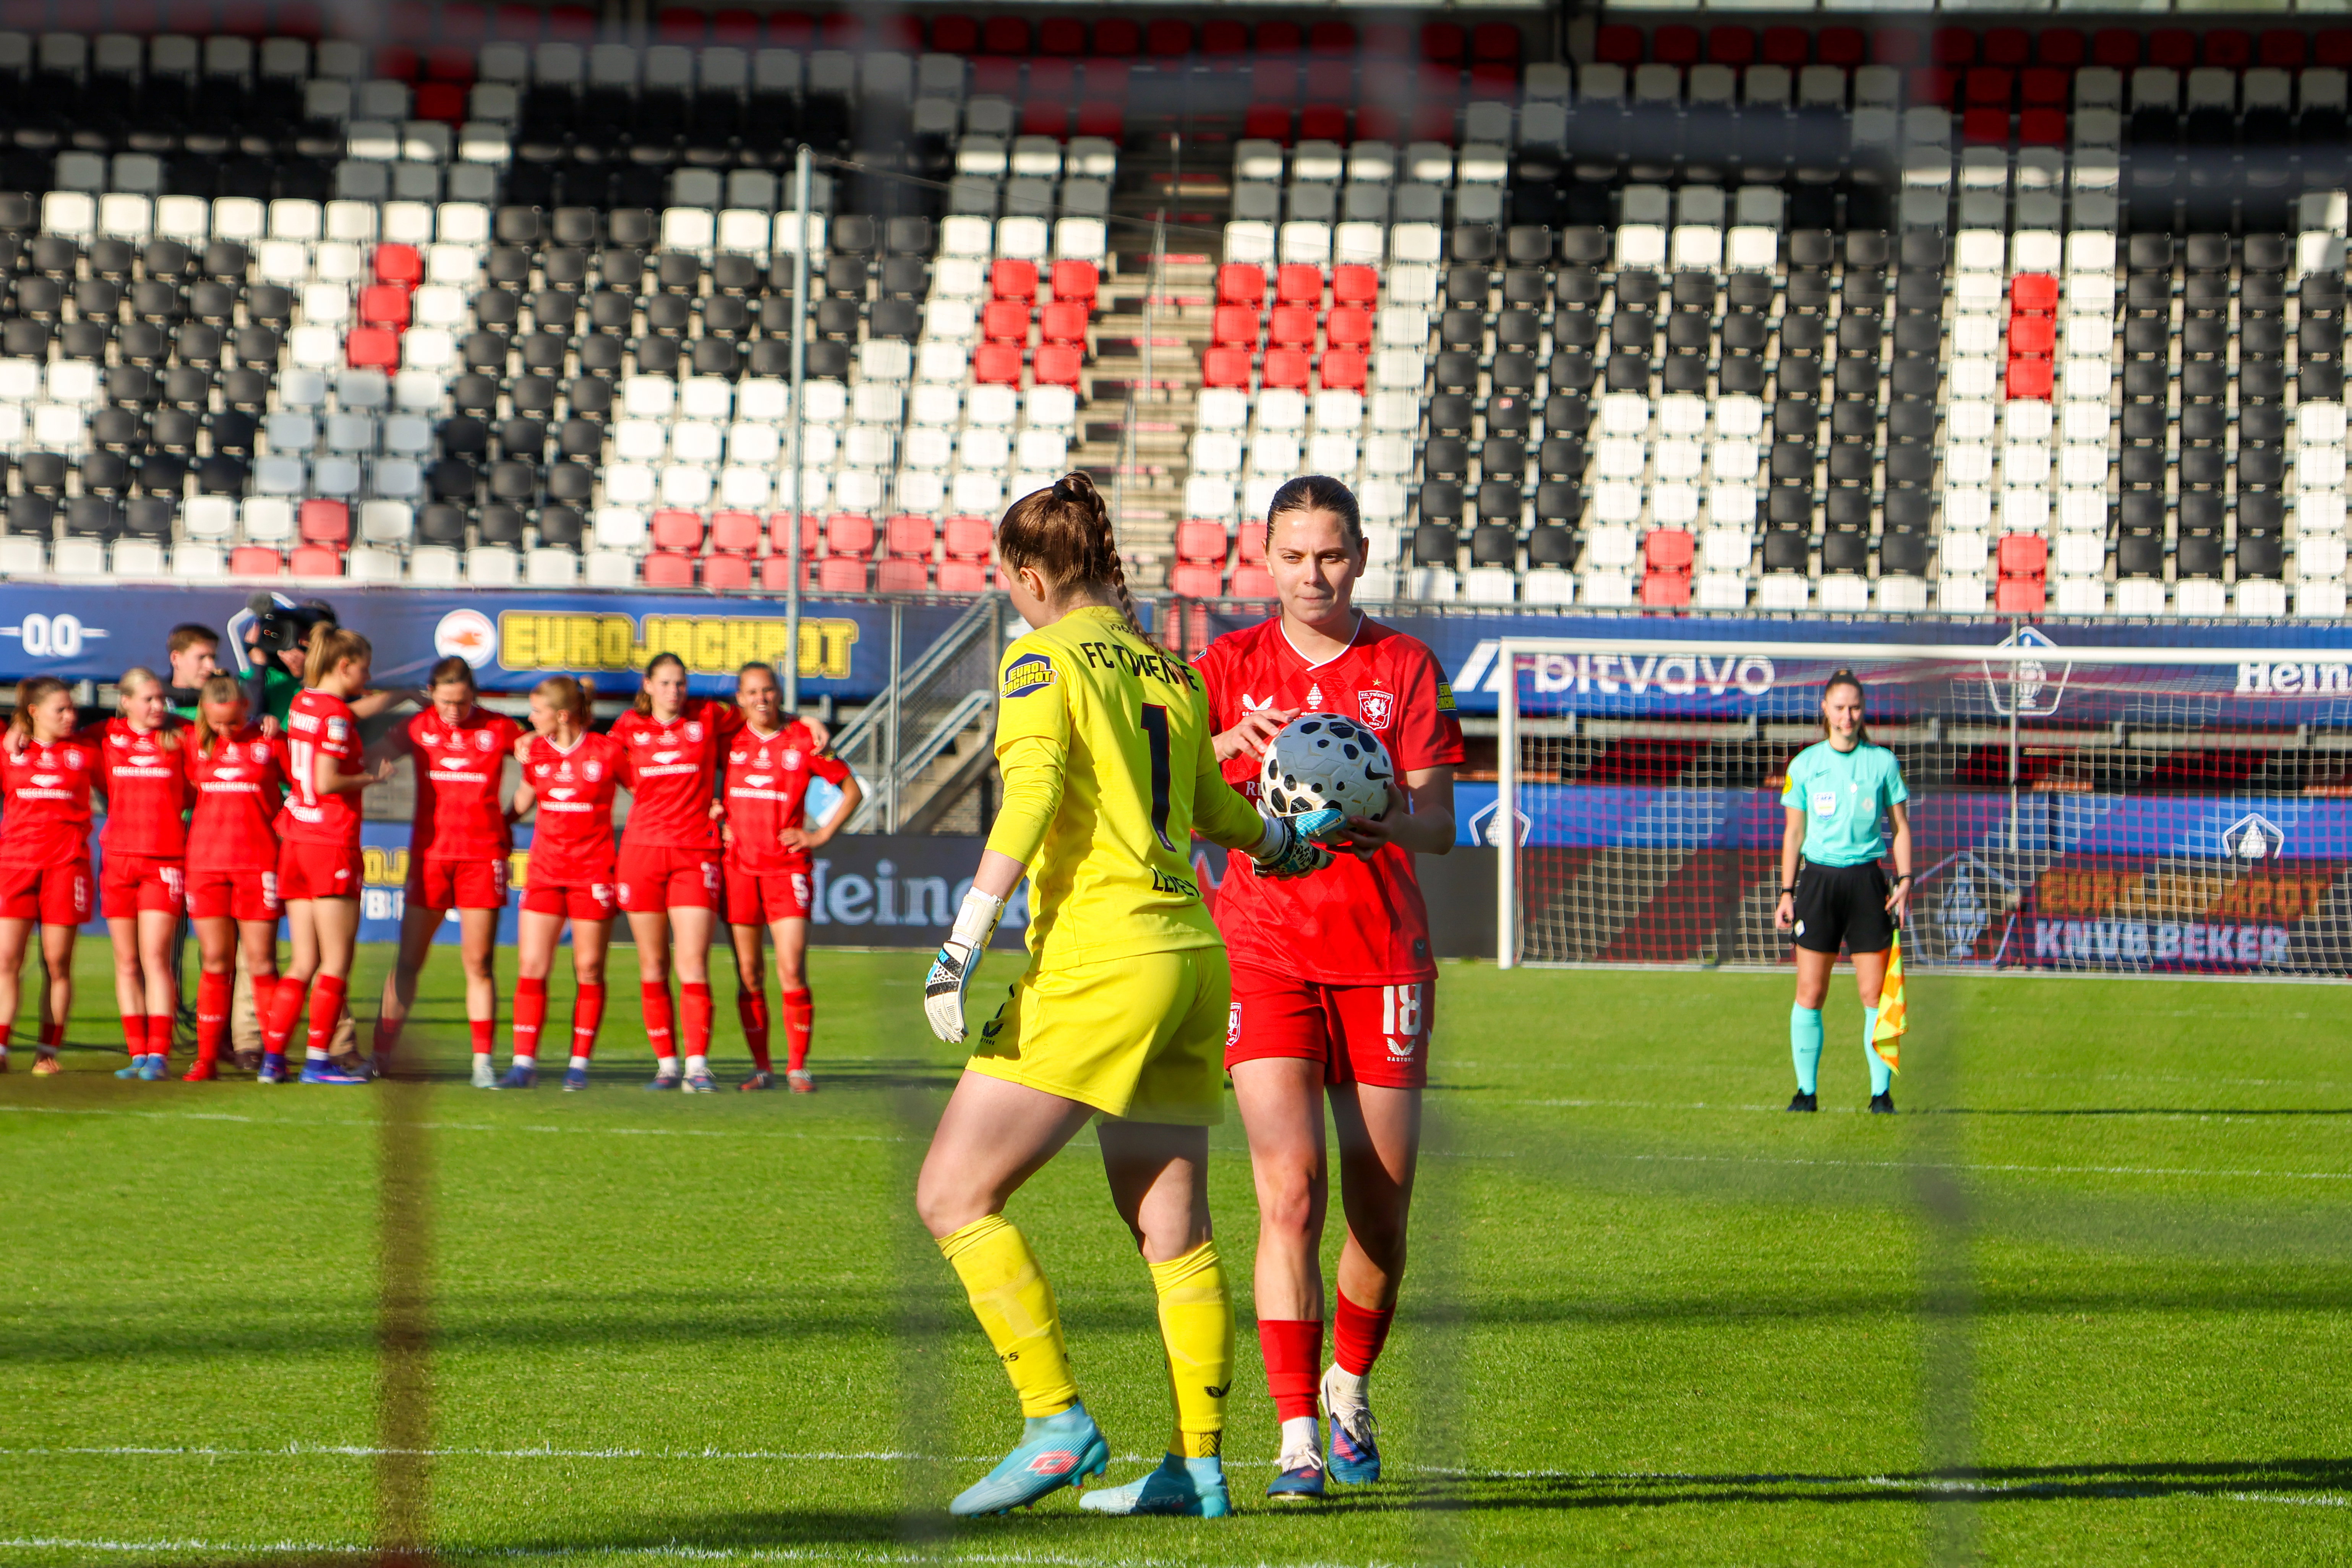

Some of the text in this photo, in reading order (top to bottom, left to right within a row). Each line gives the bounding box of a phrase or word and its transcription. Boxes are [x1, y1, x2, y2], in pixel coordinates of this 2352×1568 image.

[22, 613, 82, 657] 0.0
[1001, 670, 1052, 697] JACKPOT
[1010, 662, 1040, 681] EURO
[1079, 642, 1200, 692] FC TWENE
[1535, 652, 1776, 696] bitvavo
[2234, 661, 2352, 697] Hein
[1140, 702, 1177, 853] 1
[2034, 920, 2289, 962] KNVB BEKER
[1383, 983, 1423, 1035] 18
[980, 1038, 995, 1046] STORE
